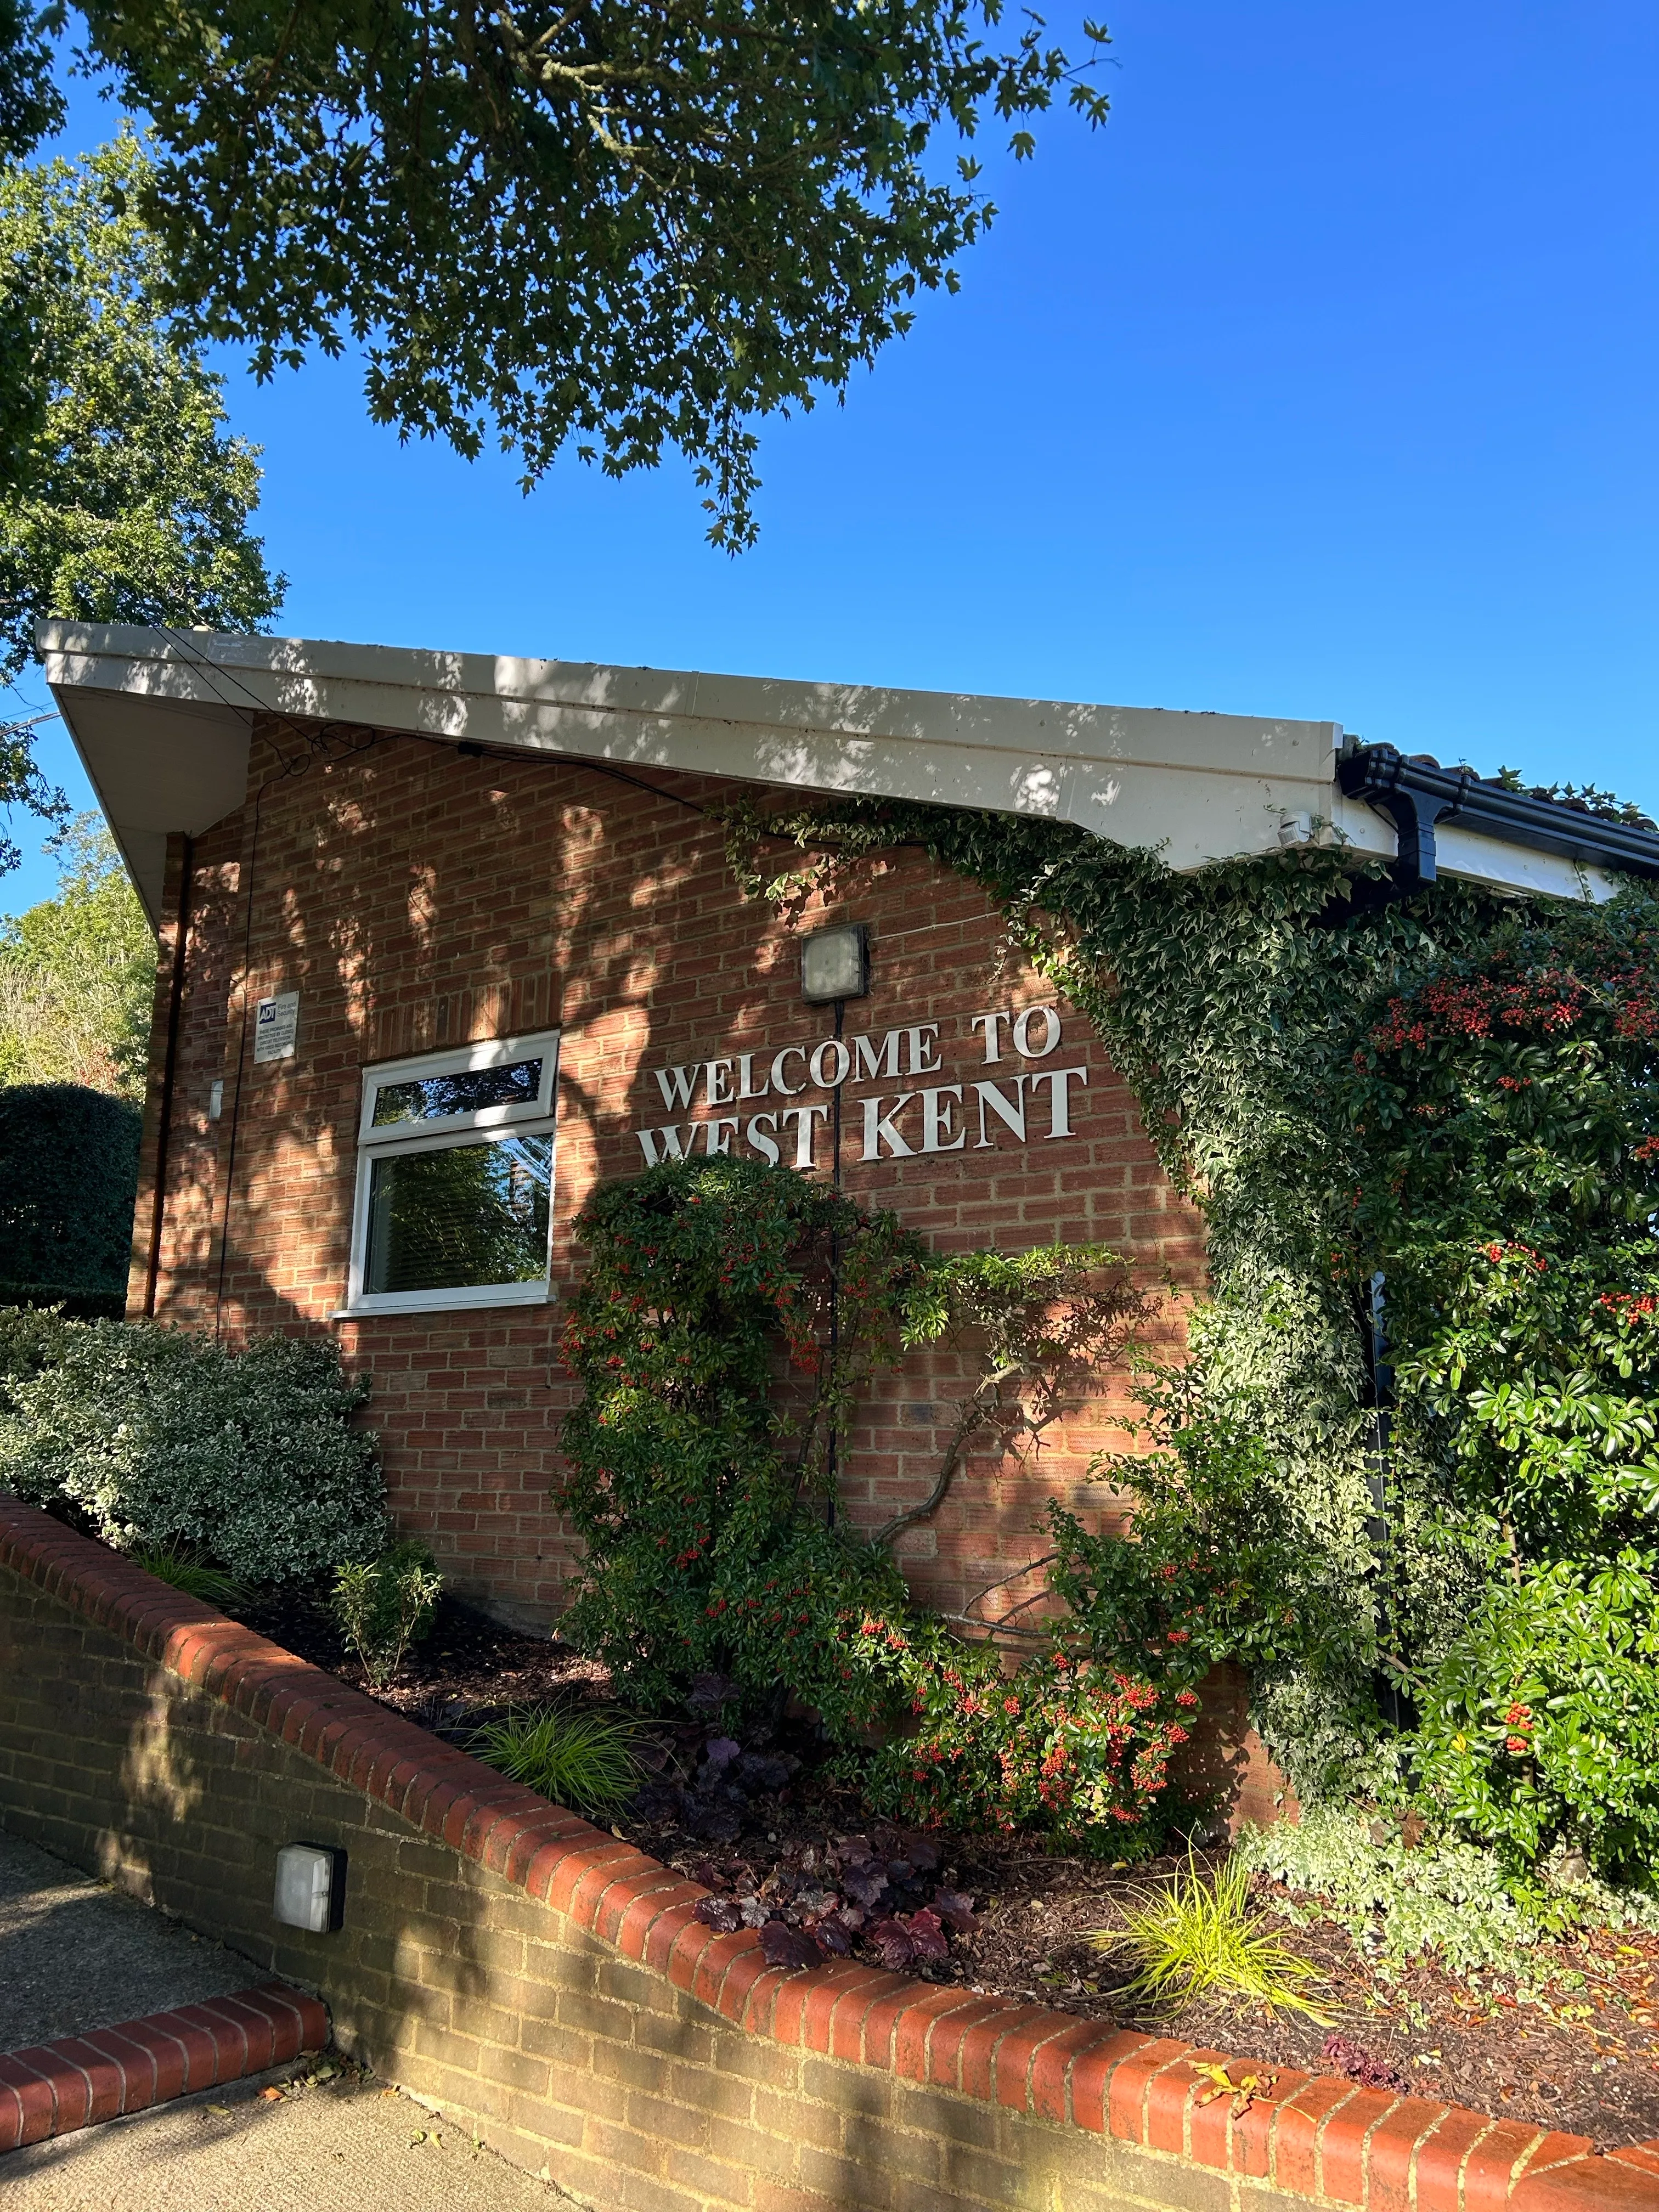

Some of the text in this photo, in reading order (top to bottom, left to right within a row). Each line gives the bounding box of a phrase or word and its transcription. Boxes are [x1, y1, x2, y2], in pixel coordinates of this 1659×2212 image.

[259, 1006, 276, 1020] ADT
[277, 1008, 295, 1017] Security
[653, 1005, 1062, 1112] WELCOME TO
[635, 1065, 1087, 1169] WEST KENT
